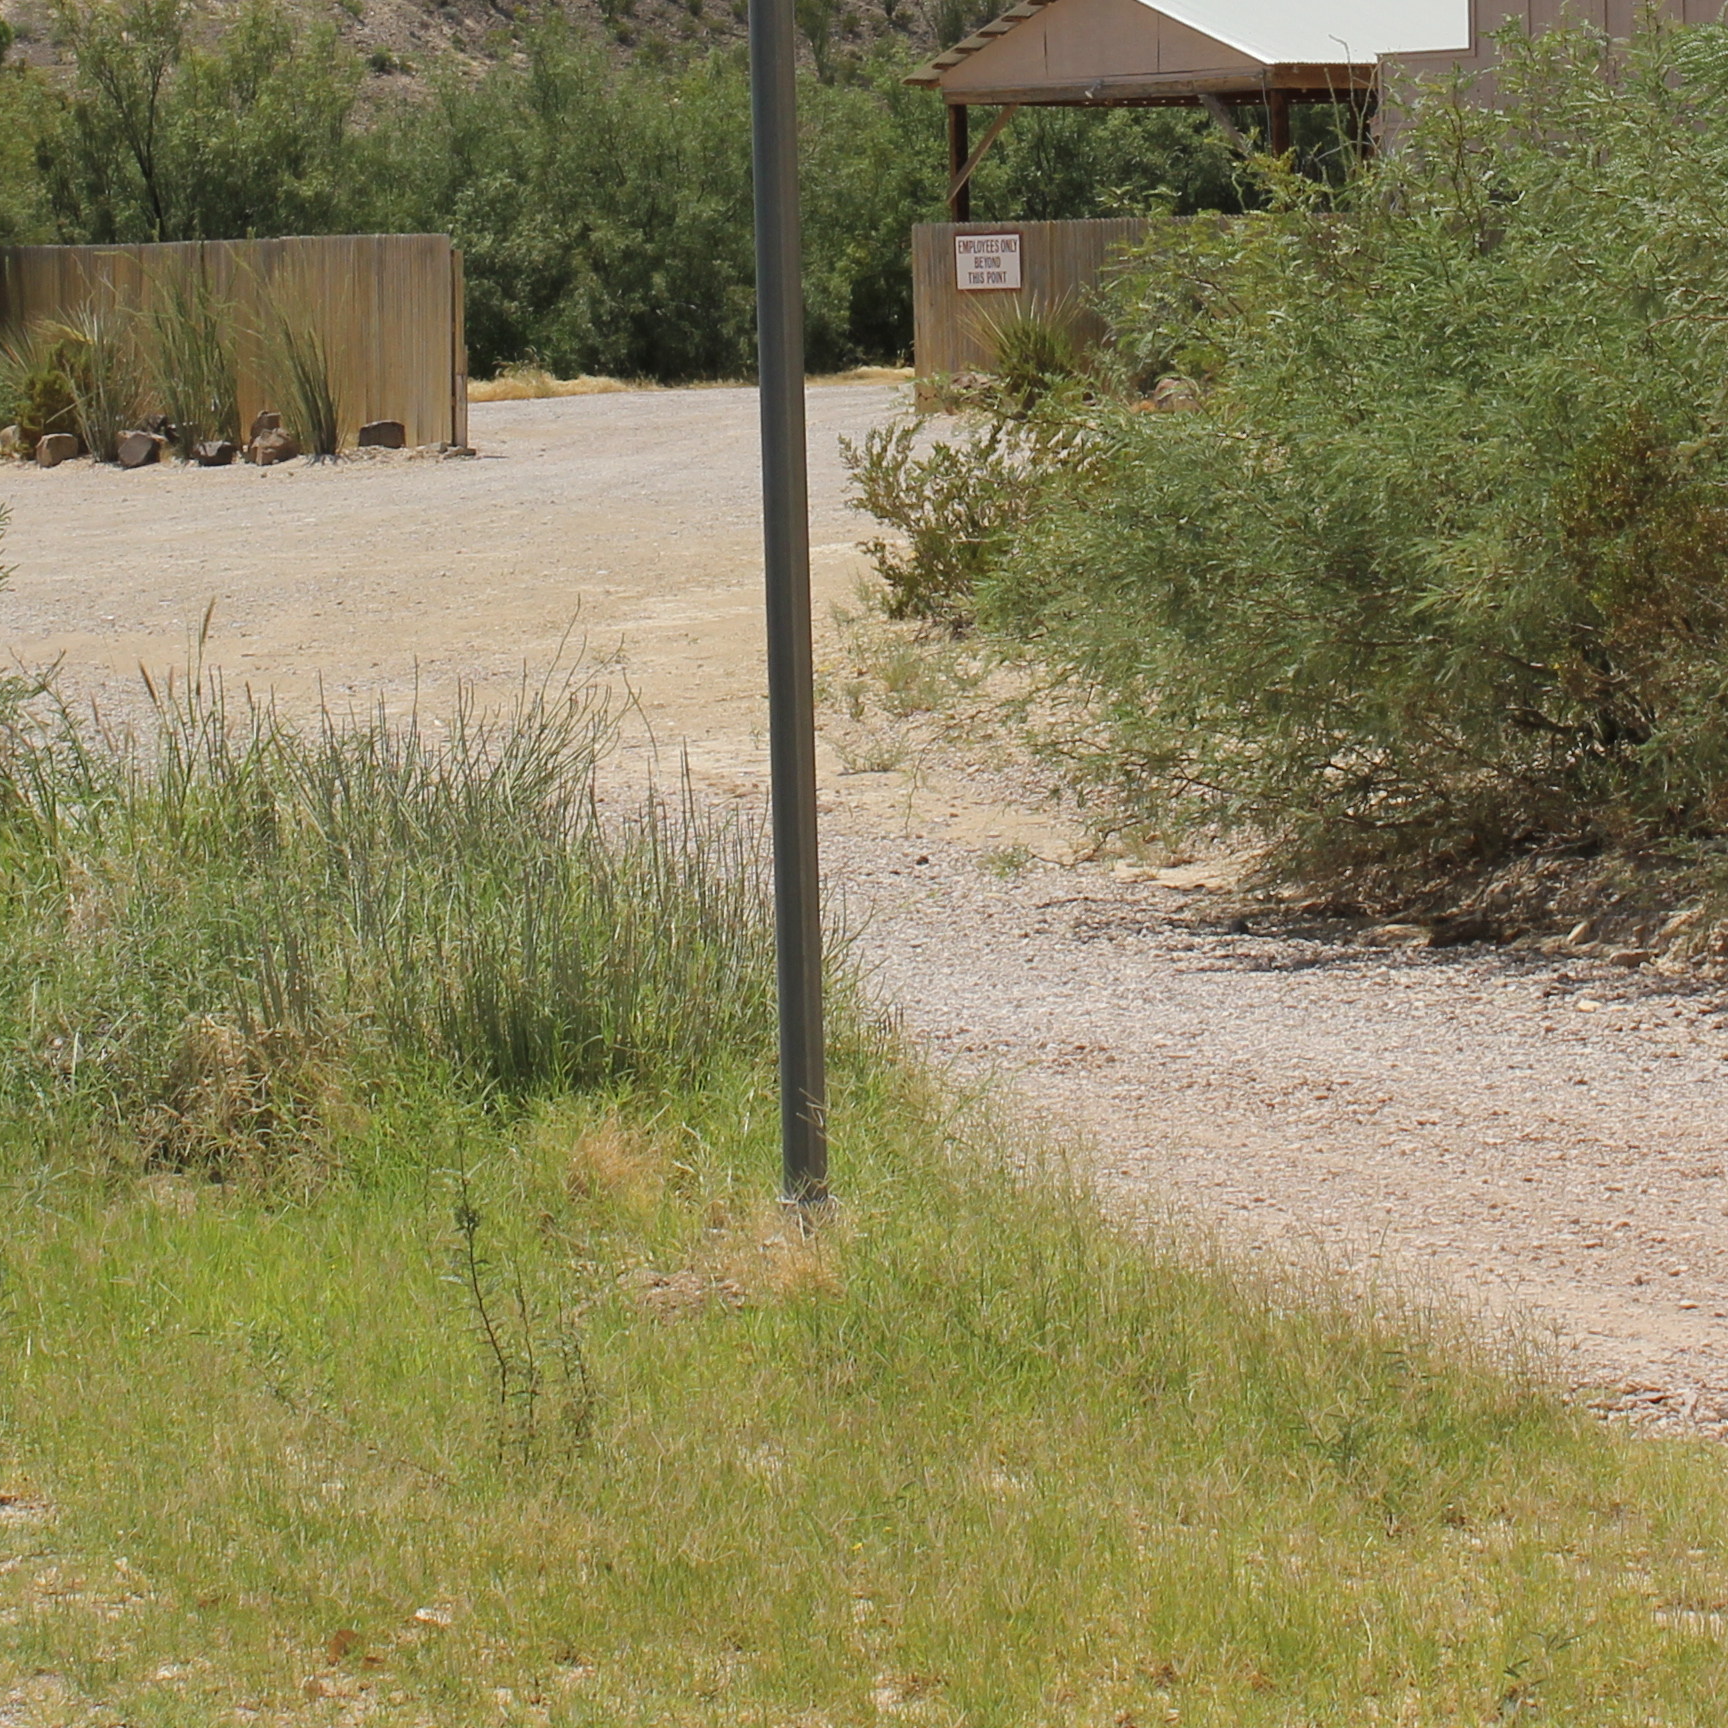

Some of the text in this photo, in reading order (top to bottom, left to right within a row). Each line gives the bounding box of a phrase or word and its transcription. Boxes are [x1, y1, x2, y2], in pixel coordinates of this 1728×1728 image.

[958, 238, 1017, 254] EMPLOYEES ONLY
[974, 256, 1001, 269] BEYOND
[968, 271, 1007, 284] THIS POINT
